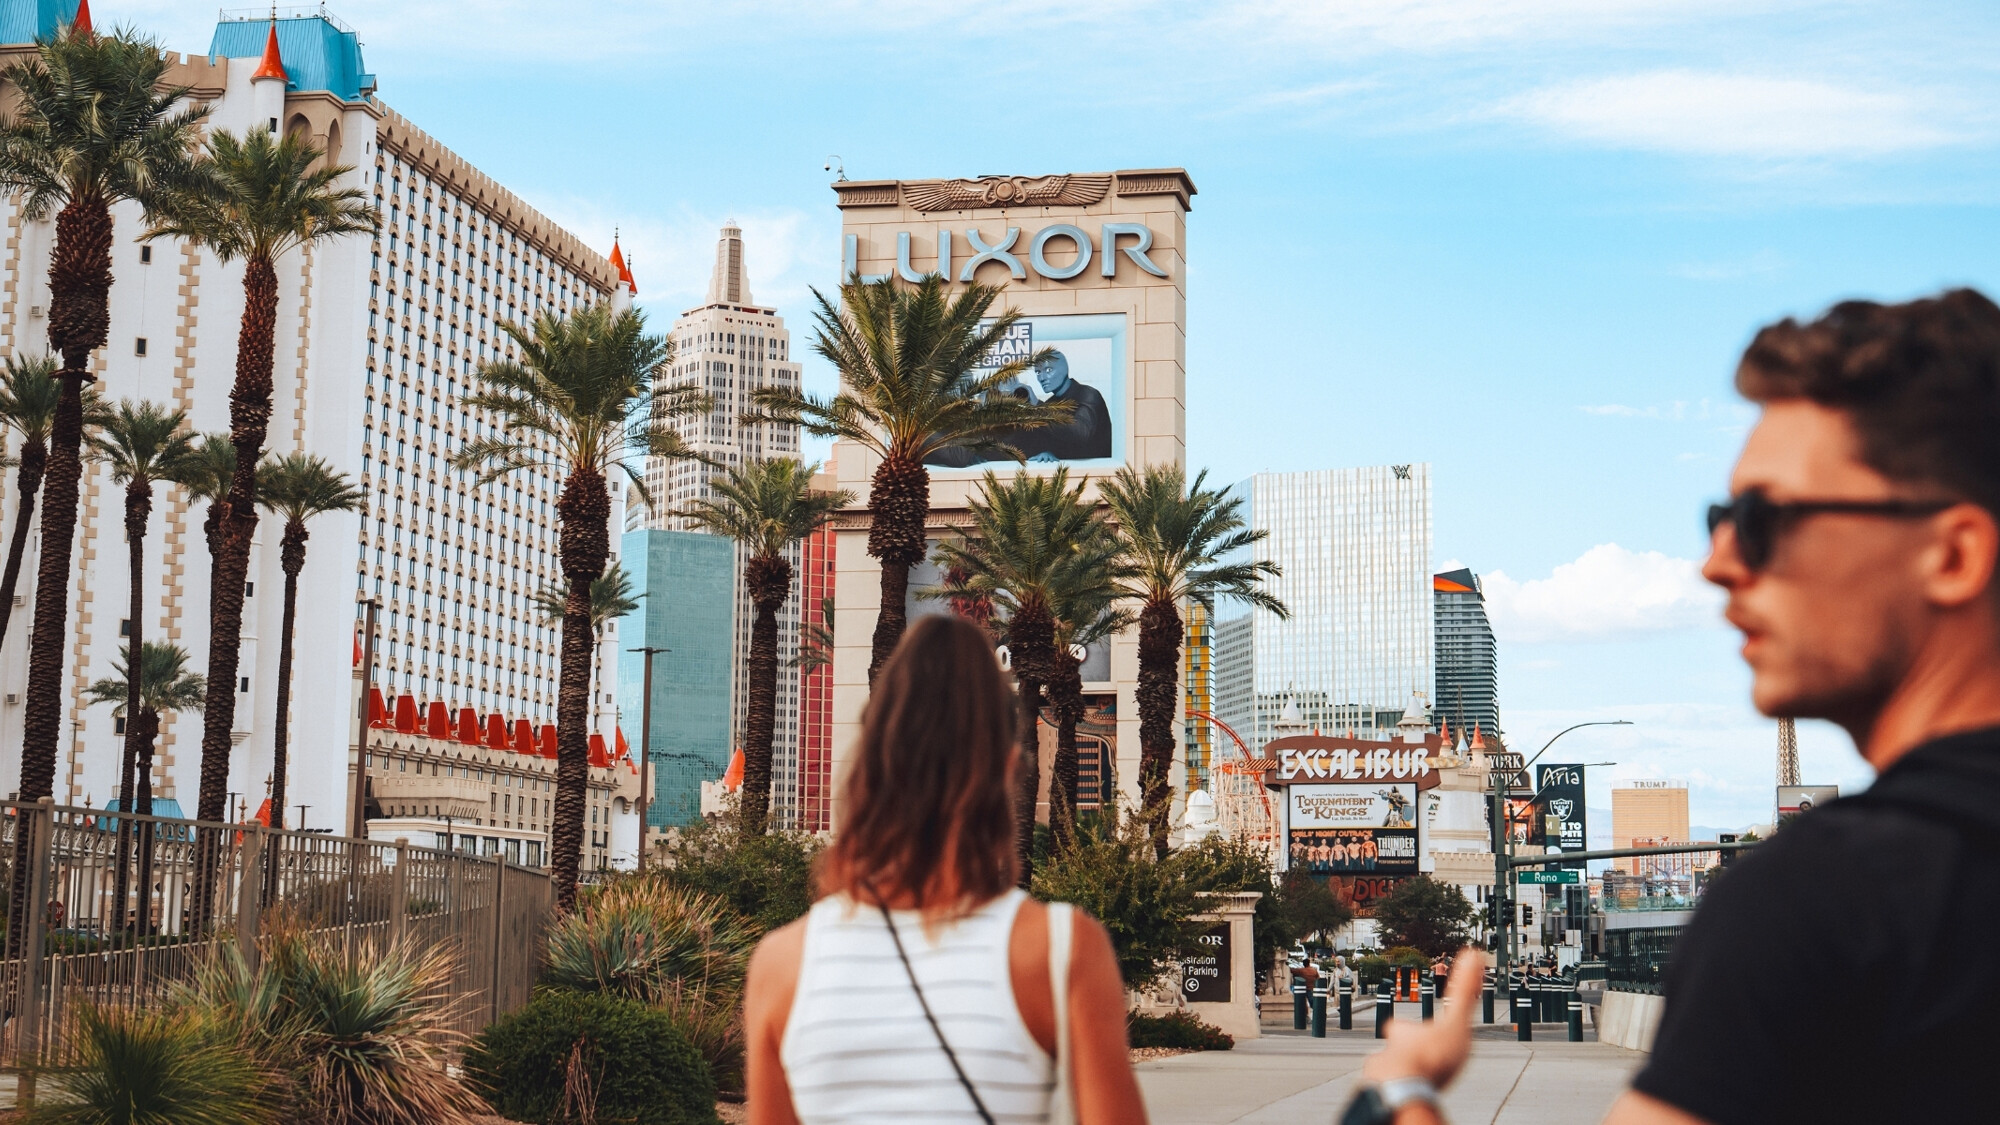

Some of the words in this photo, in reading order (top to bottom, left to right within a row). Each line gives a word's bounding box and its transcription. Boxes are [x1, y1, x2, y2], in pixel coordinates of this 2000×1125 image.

[843, 222, 1169, 287] LUXOR
[1281, 748, 1430, 780] EXCALIBUR
[1633, 781, 1667, 789] TRUMP
[1294, 795, 1375, 809] TOURNAMENT
[1314, 806, 1368, 820] KINGS
[1567, 822, 1582, 831] TO
[1376, 837, 1415, 849] THUNDER
[1534, 872, 1558, 882] Reno
[1188, 966, 1218, 978] Parking
